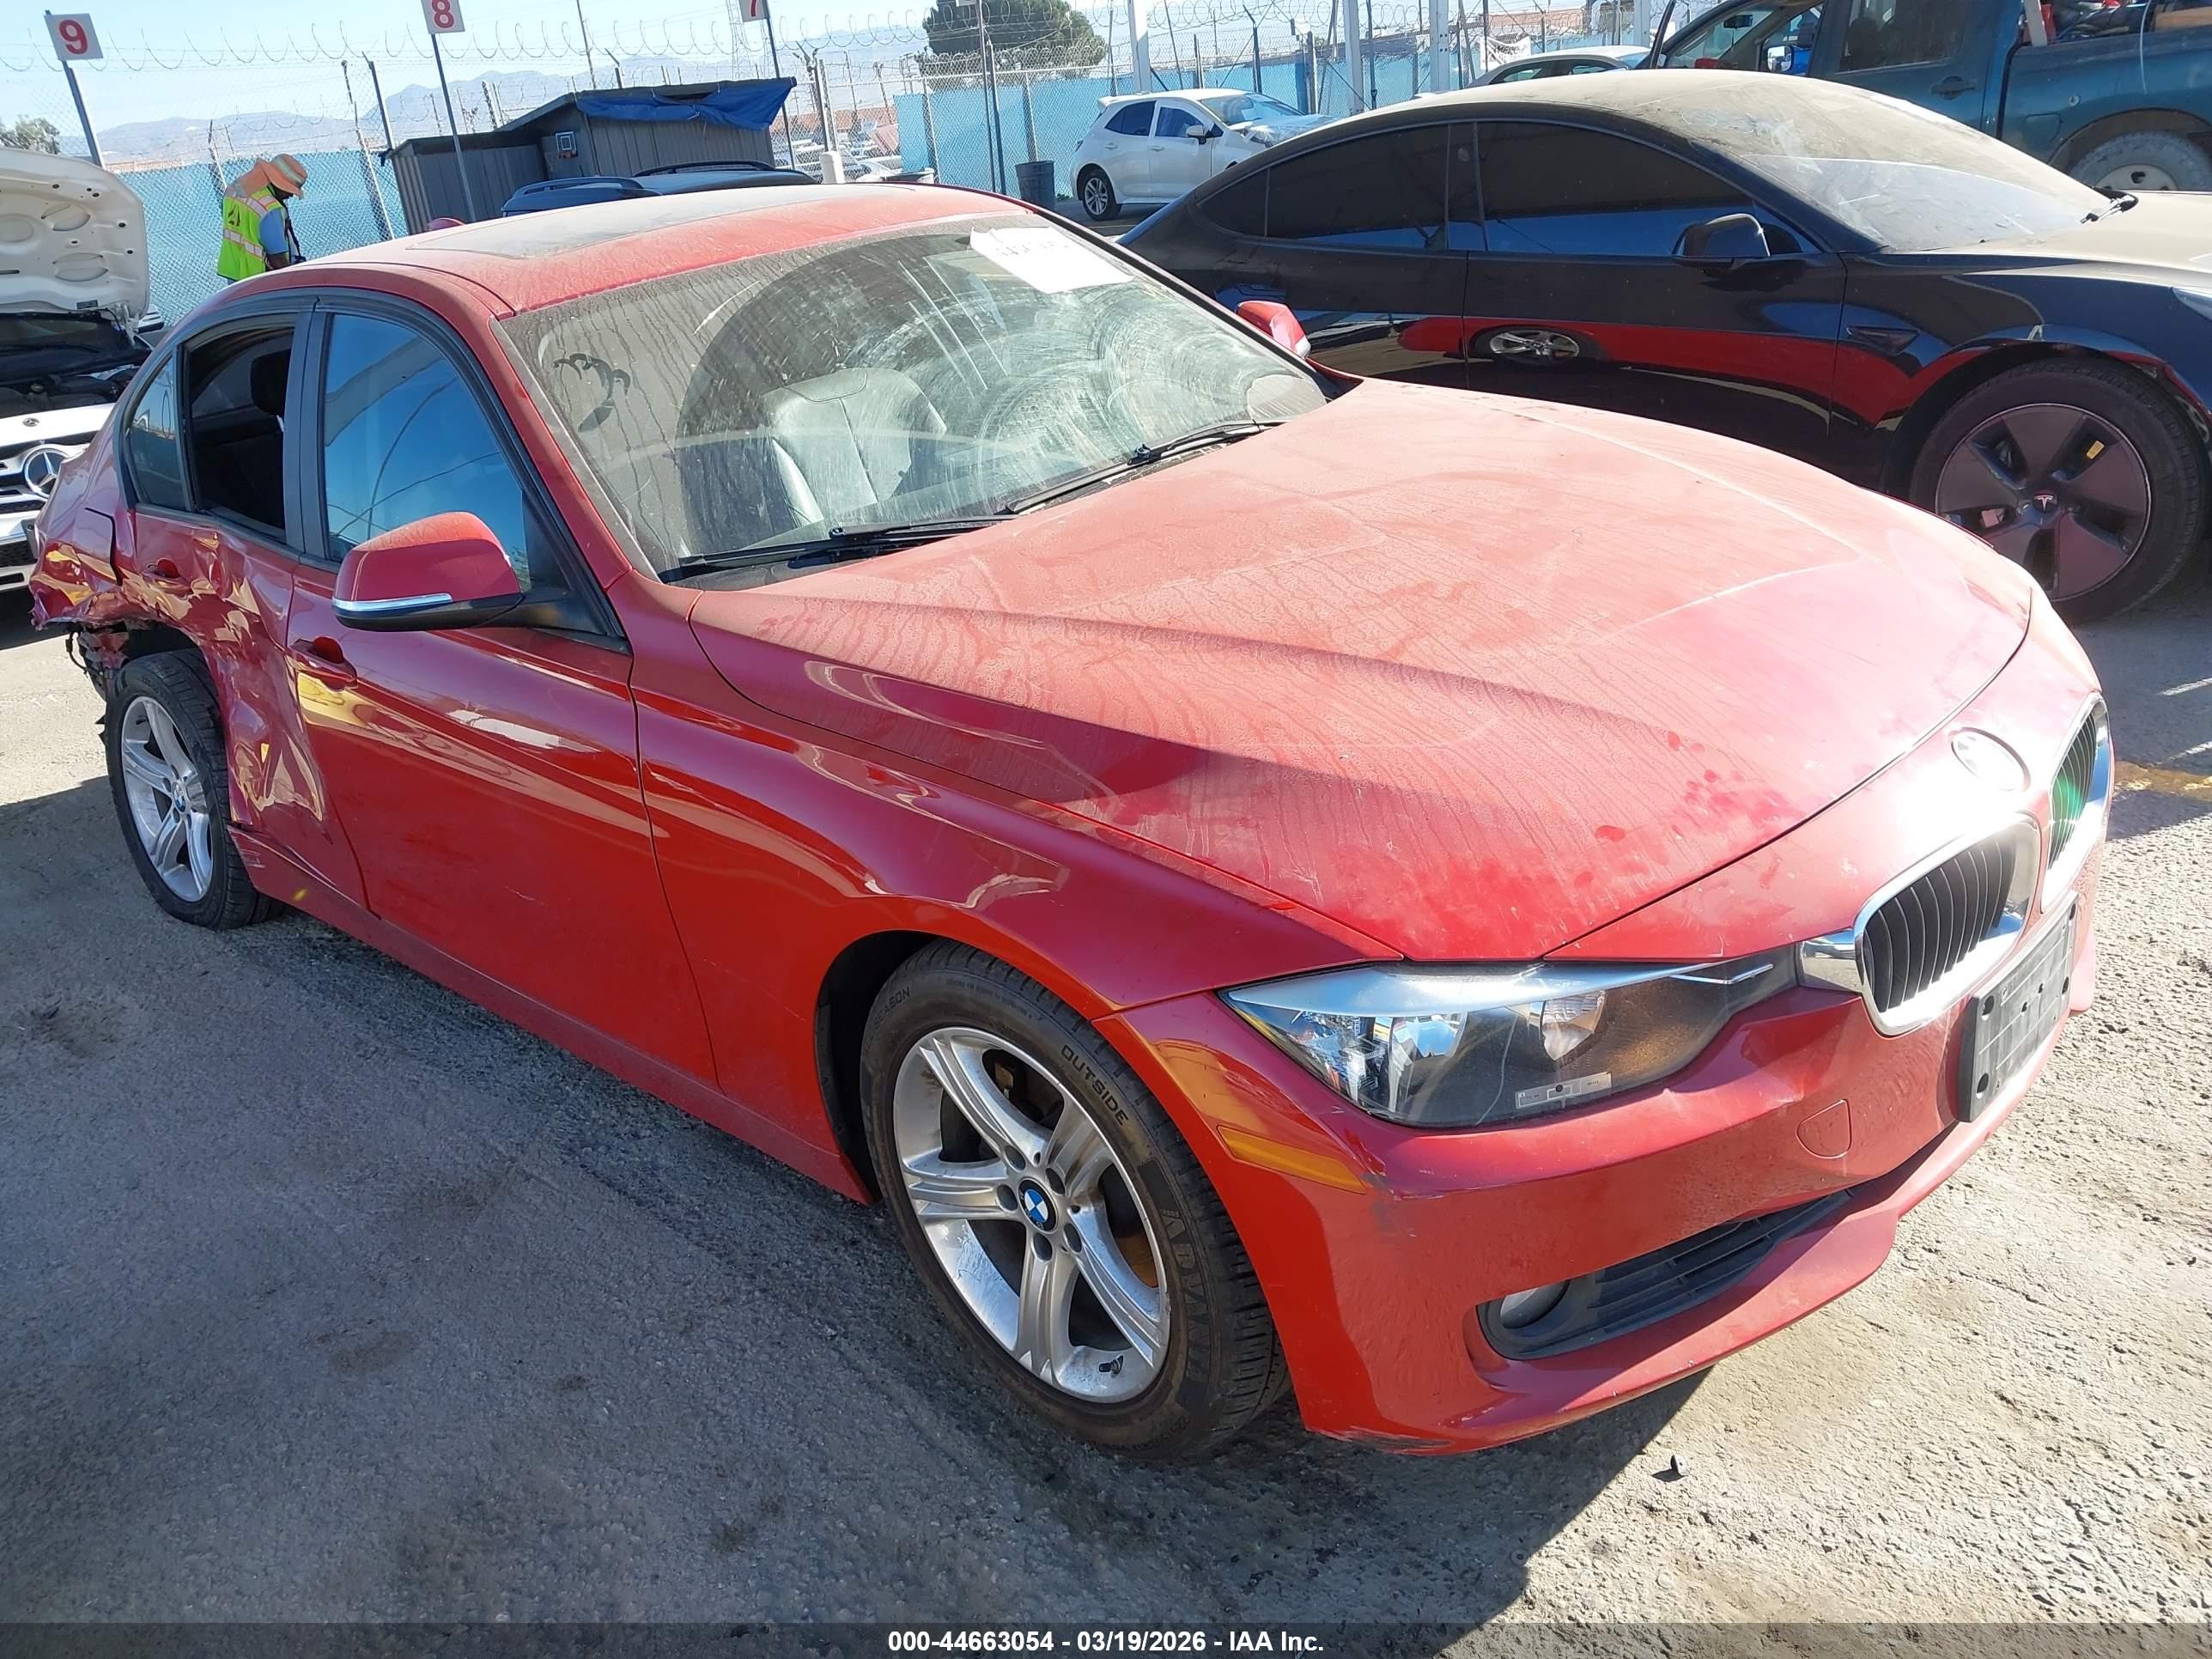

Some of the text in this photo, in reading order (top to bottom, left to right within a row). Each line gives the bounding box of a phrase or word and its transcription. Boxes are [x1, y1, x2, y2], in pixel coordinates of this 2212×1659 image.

[431, 0, 454, 28] 8
[58, 19, 88, 55] 9
[1060, 1043, 1129, 1127] OUTSIDE
